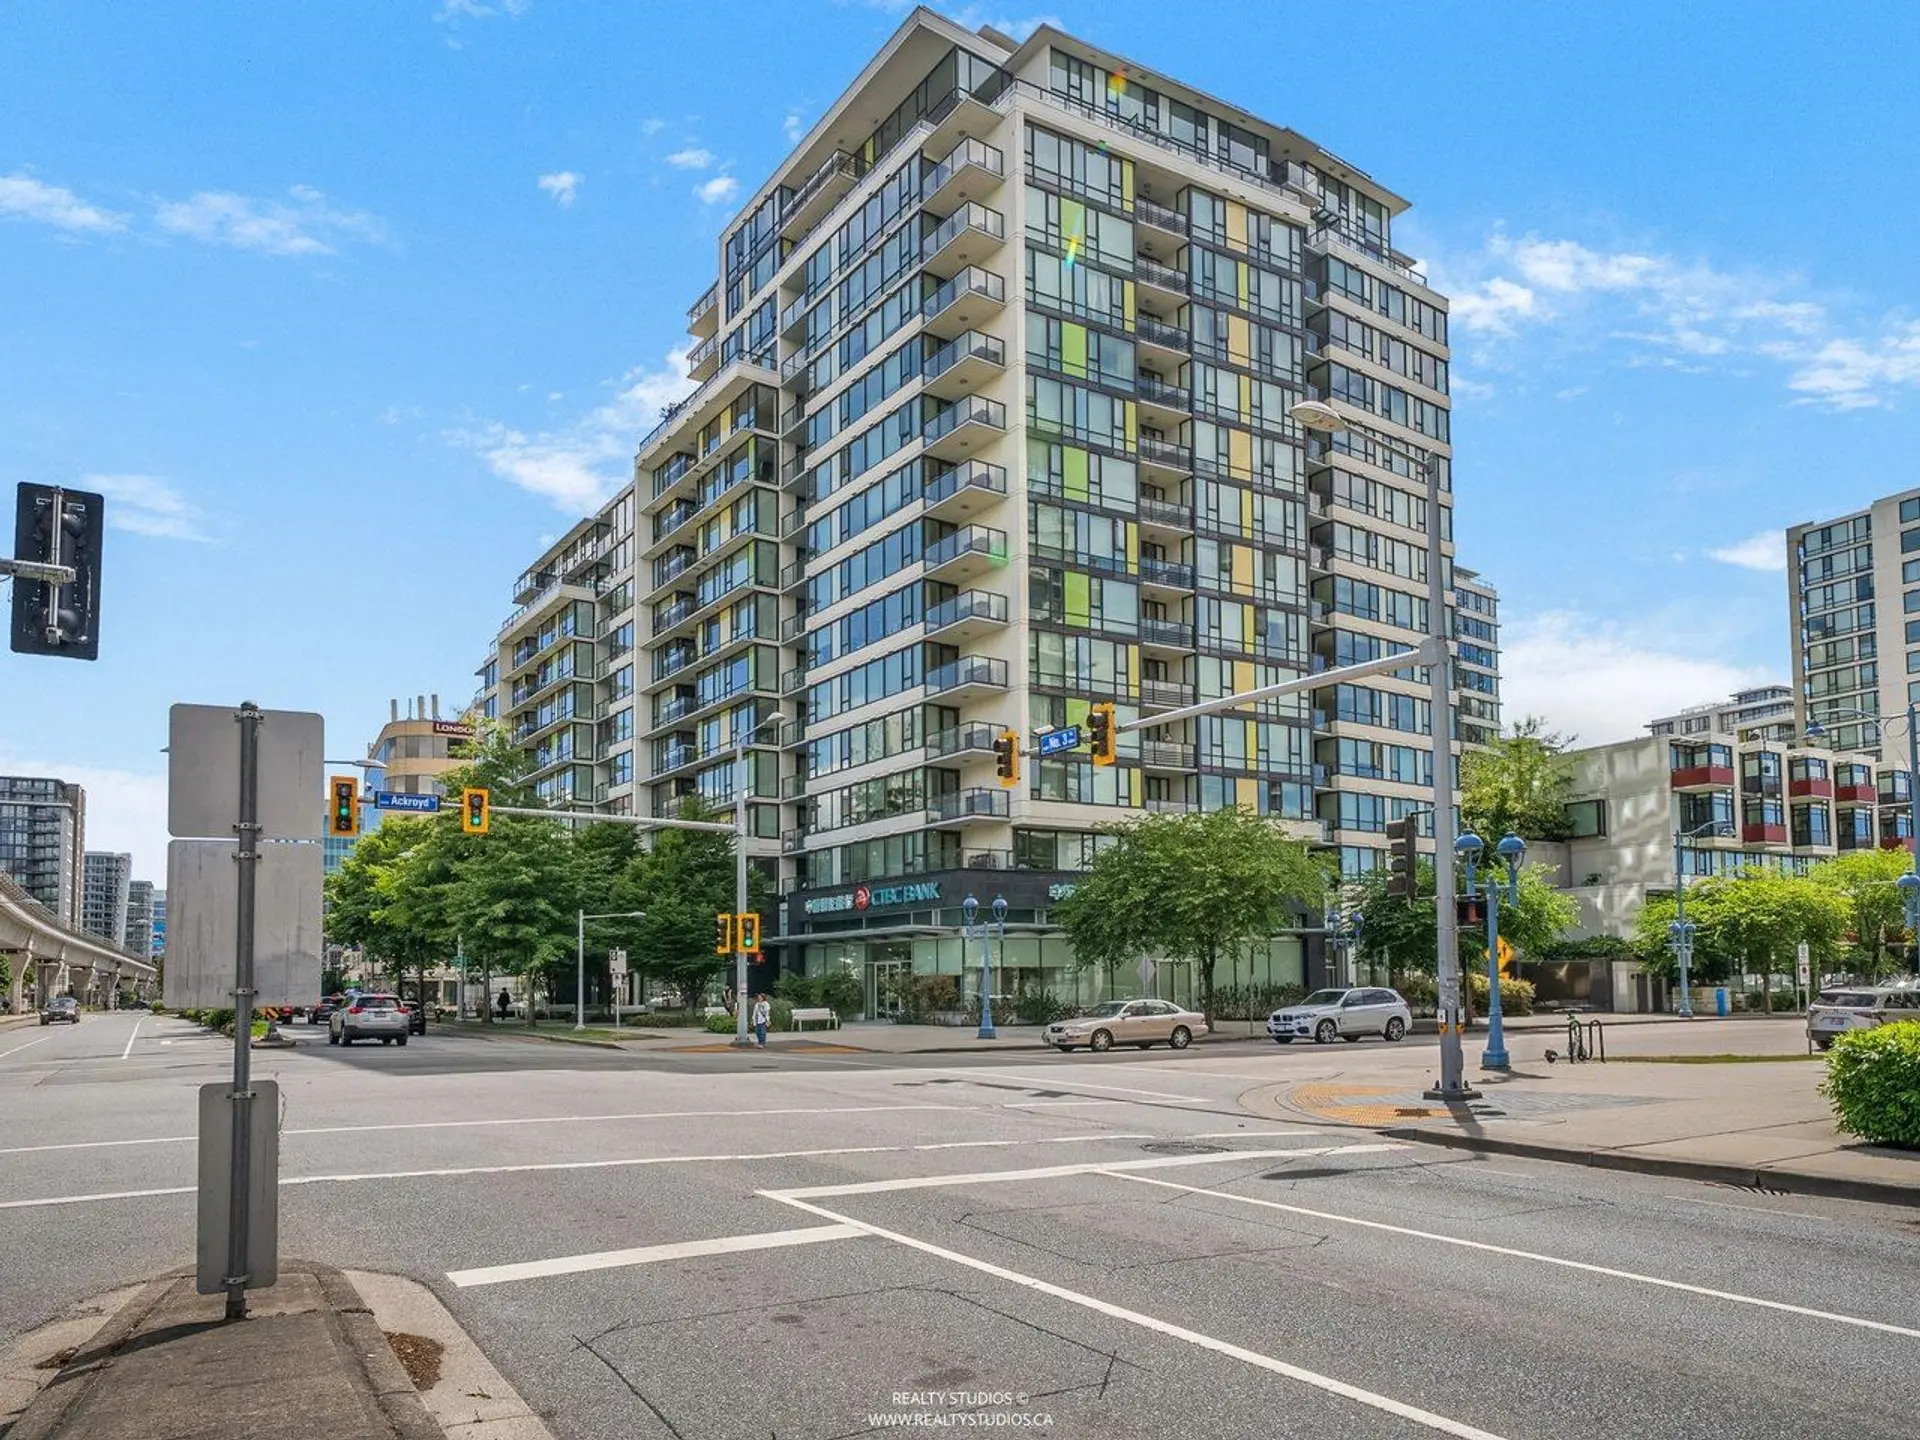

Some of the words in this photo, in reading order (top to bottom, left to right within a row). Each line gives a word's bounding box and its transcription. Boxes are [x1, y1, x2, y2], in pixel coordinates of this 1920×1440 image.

[391, 796, 429, 809] Ackroyd
[872, 886, 903, 905] CTBC
[904, 882, 940, 902] BANK
